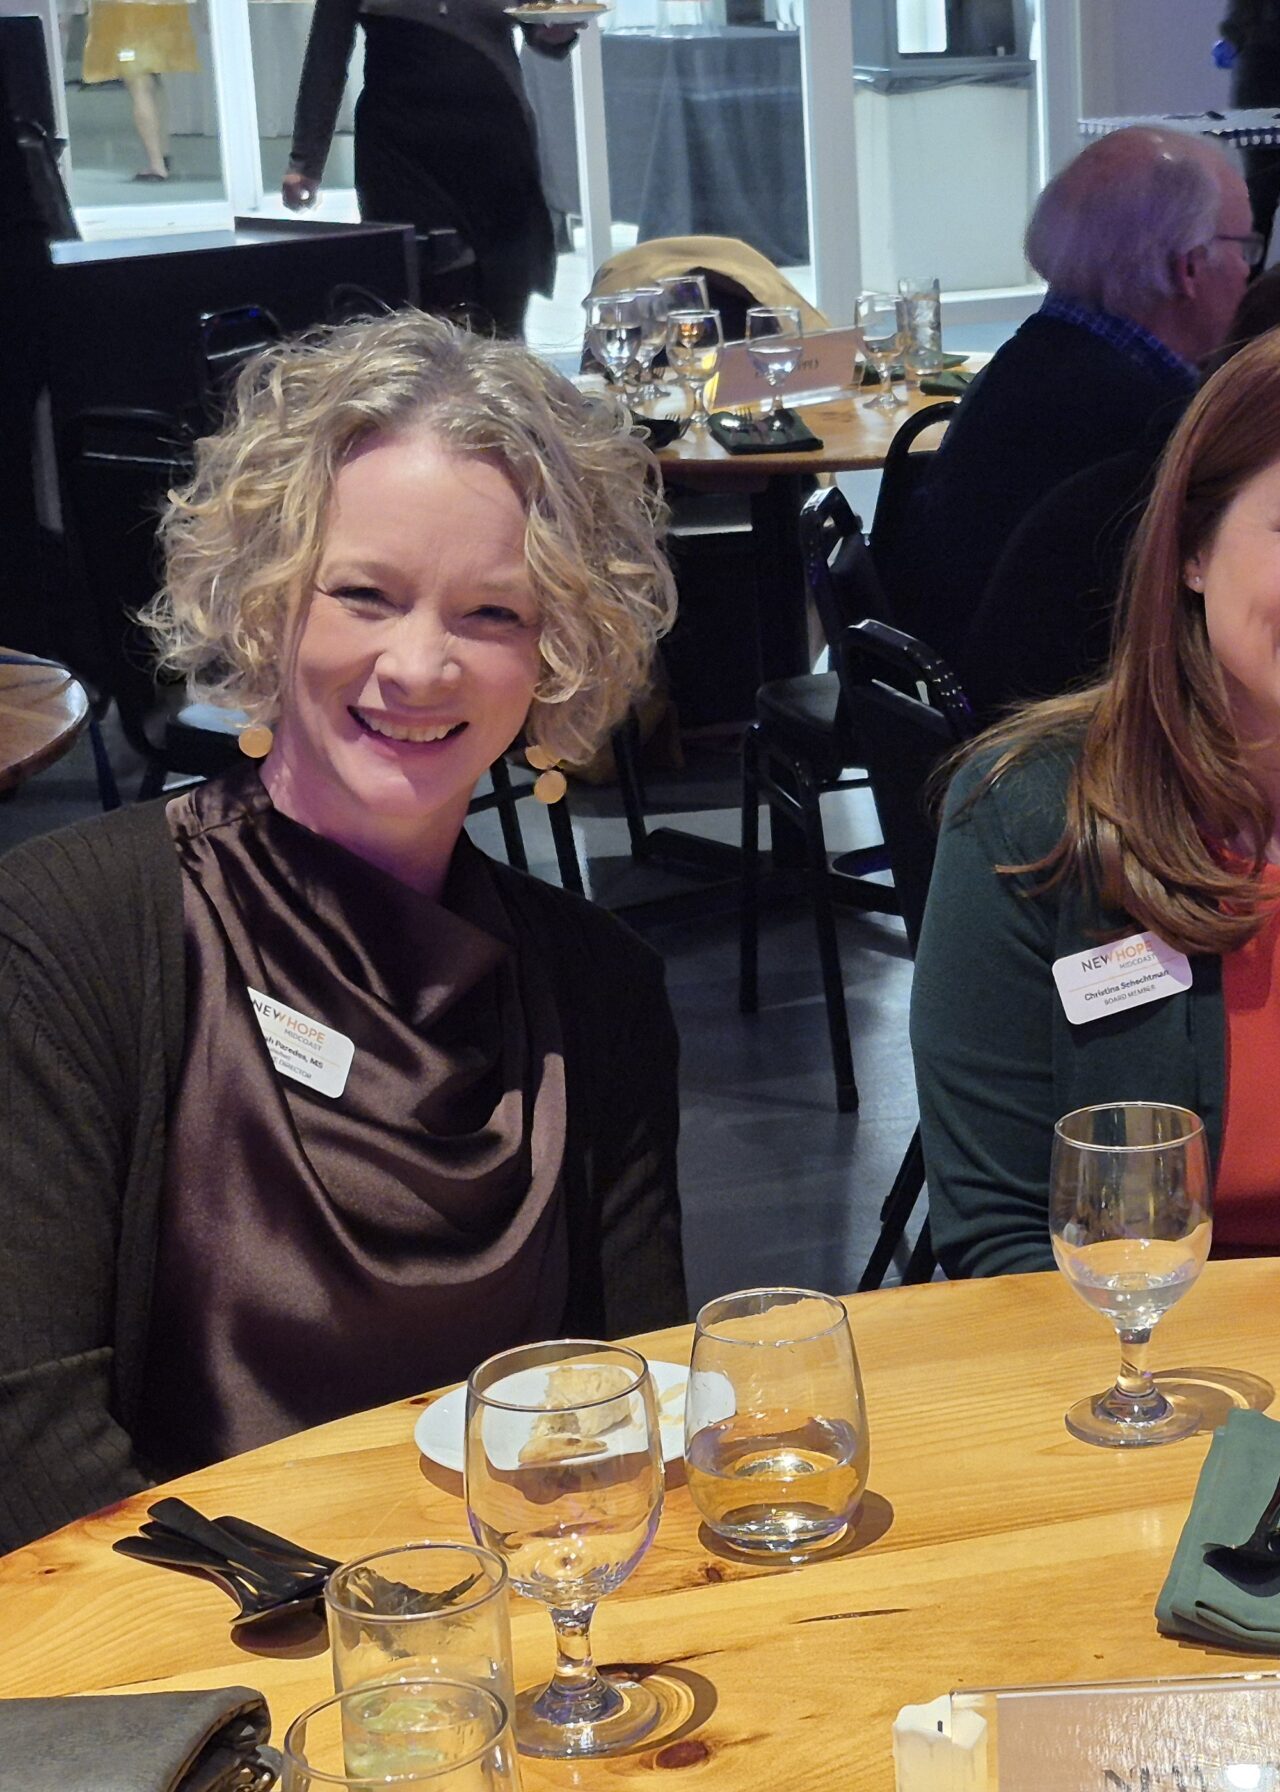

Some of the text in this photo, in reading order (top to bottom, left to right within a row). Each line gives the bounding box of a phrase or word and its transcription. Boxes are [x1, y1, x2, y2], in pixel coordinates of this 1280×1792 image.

[1081, 940, 1154, 973] NEW HOPE
[1084, 985, 1120, 1001] Christina
[1103, 984, 1157, 1006] BOARD MEMBER
[252, 999, 327, 1045] NEW HOPE
